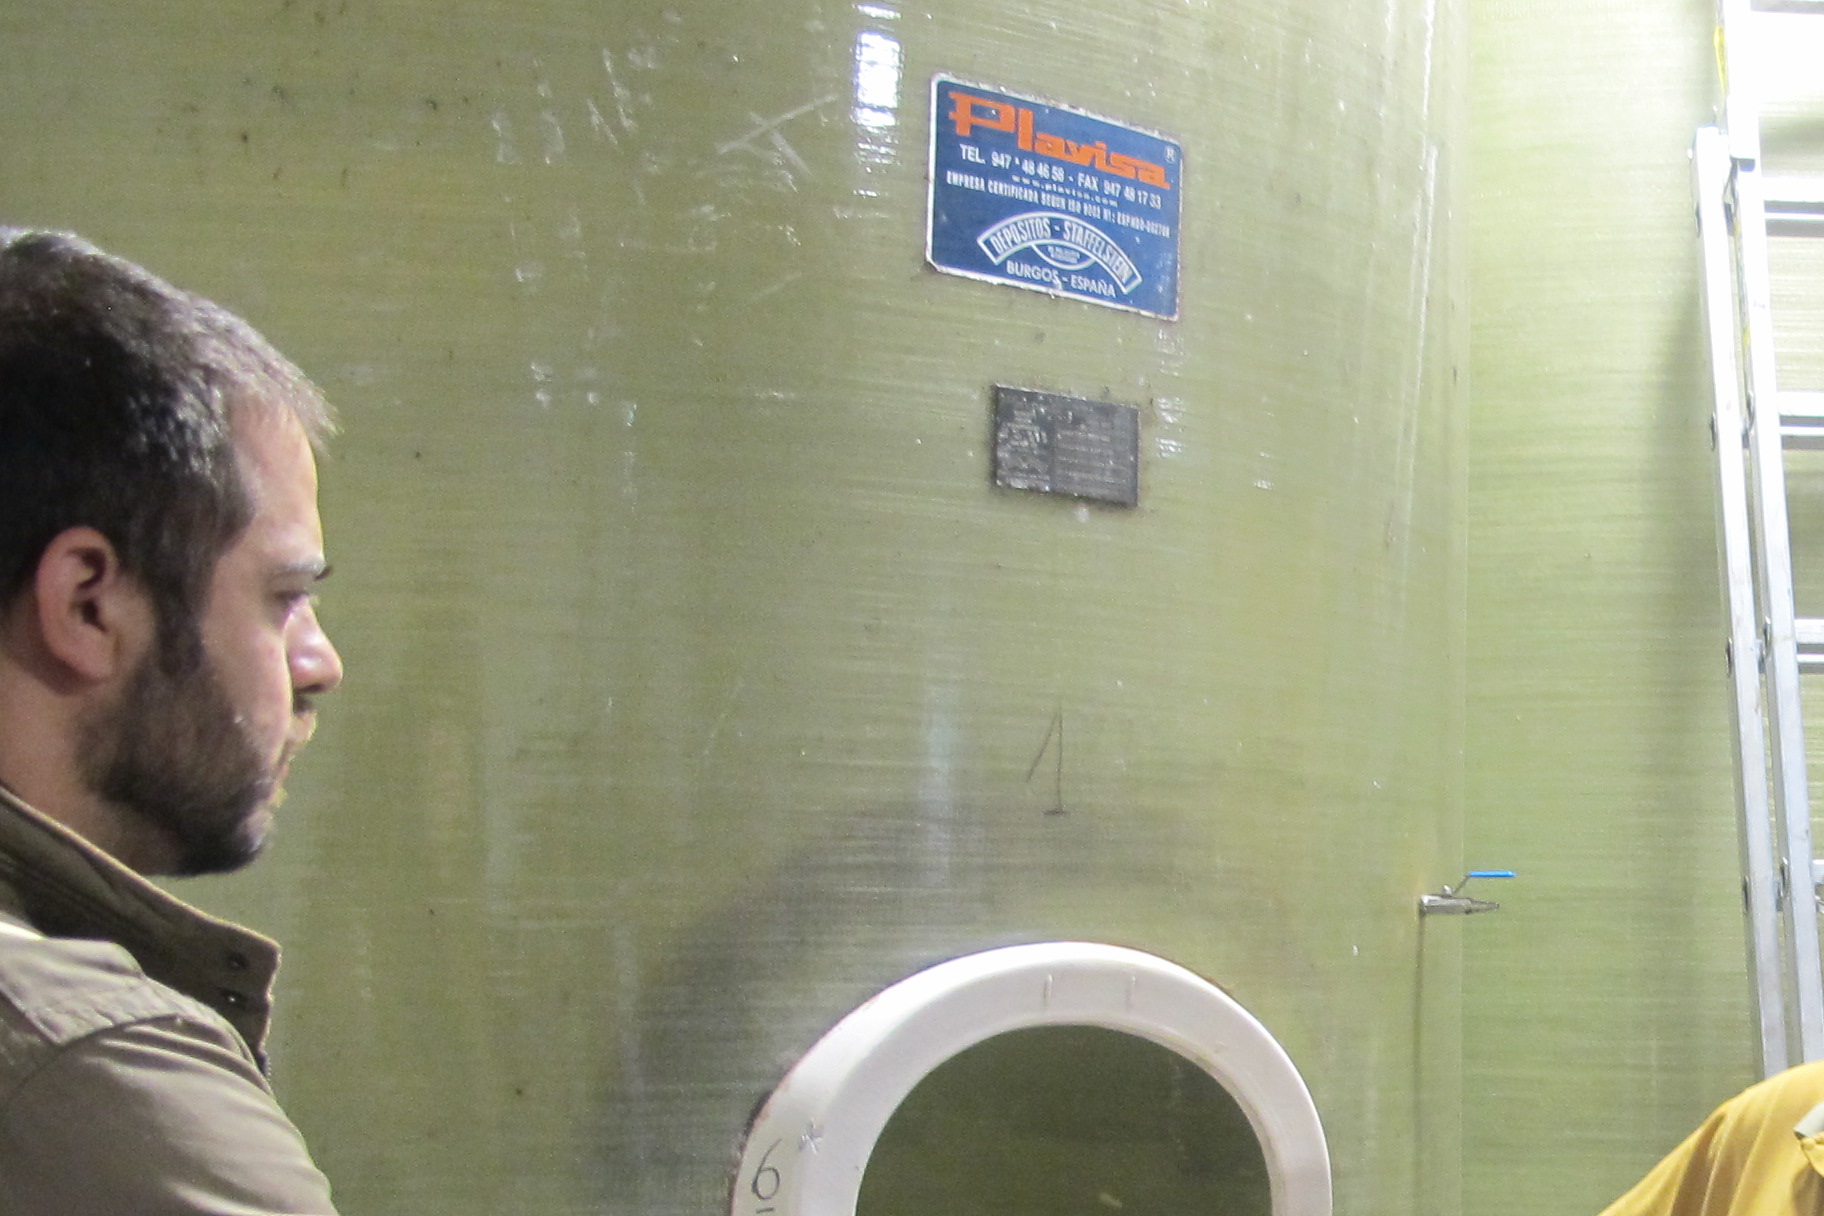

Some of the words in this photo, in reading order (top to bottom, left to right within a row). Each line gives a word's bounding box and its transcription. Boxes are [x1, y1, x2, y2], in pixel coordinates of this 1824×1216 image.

[949, 92, 1171, 190] Plavisa
[946, 170, 986, 192] EMPRESA
[987, 179, 1039, 204] CERTIFICADA
[959, 143, 985, 166] TEL.
[991, 151, 1012, 170] 947
[1078, 172, 1099, 192] FAX
[1103, 179, 1121, 198] 947
[1137, 189, 1149, 206] 17
[990, 218, 1052, 253] DEPOSITOS
[1063, 220, 1134, 284] STAFFELSTEIN
[1006, 260, 1060, 287] BURGOS
[1071, 274, 1116, 298] ESPAÑA
[751, 1139, 782, 1200] 6
